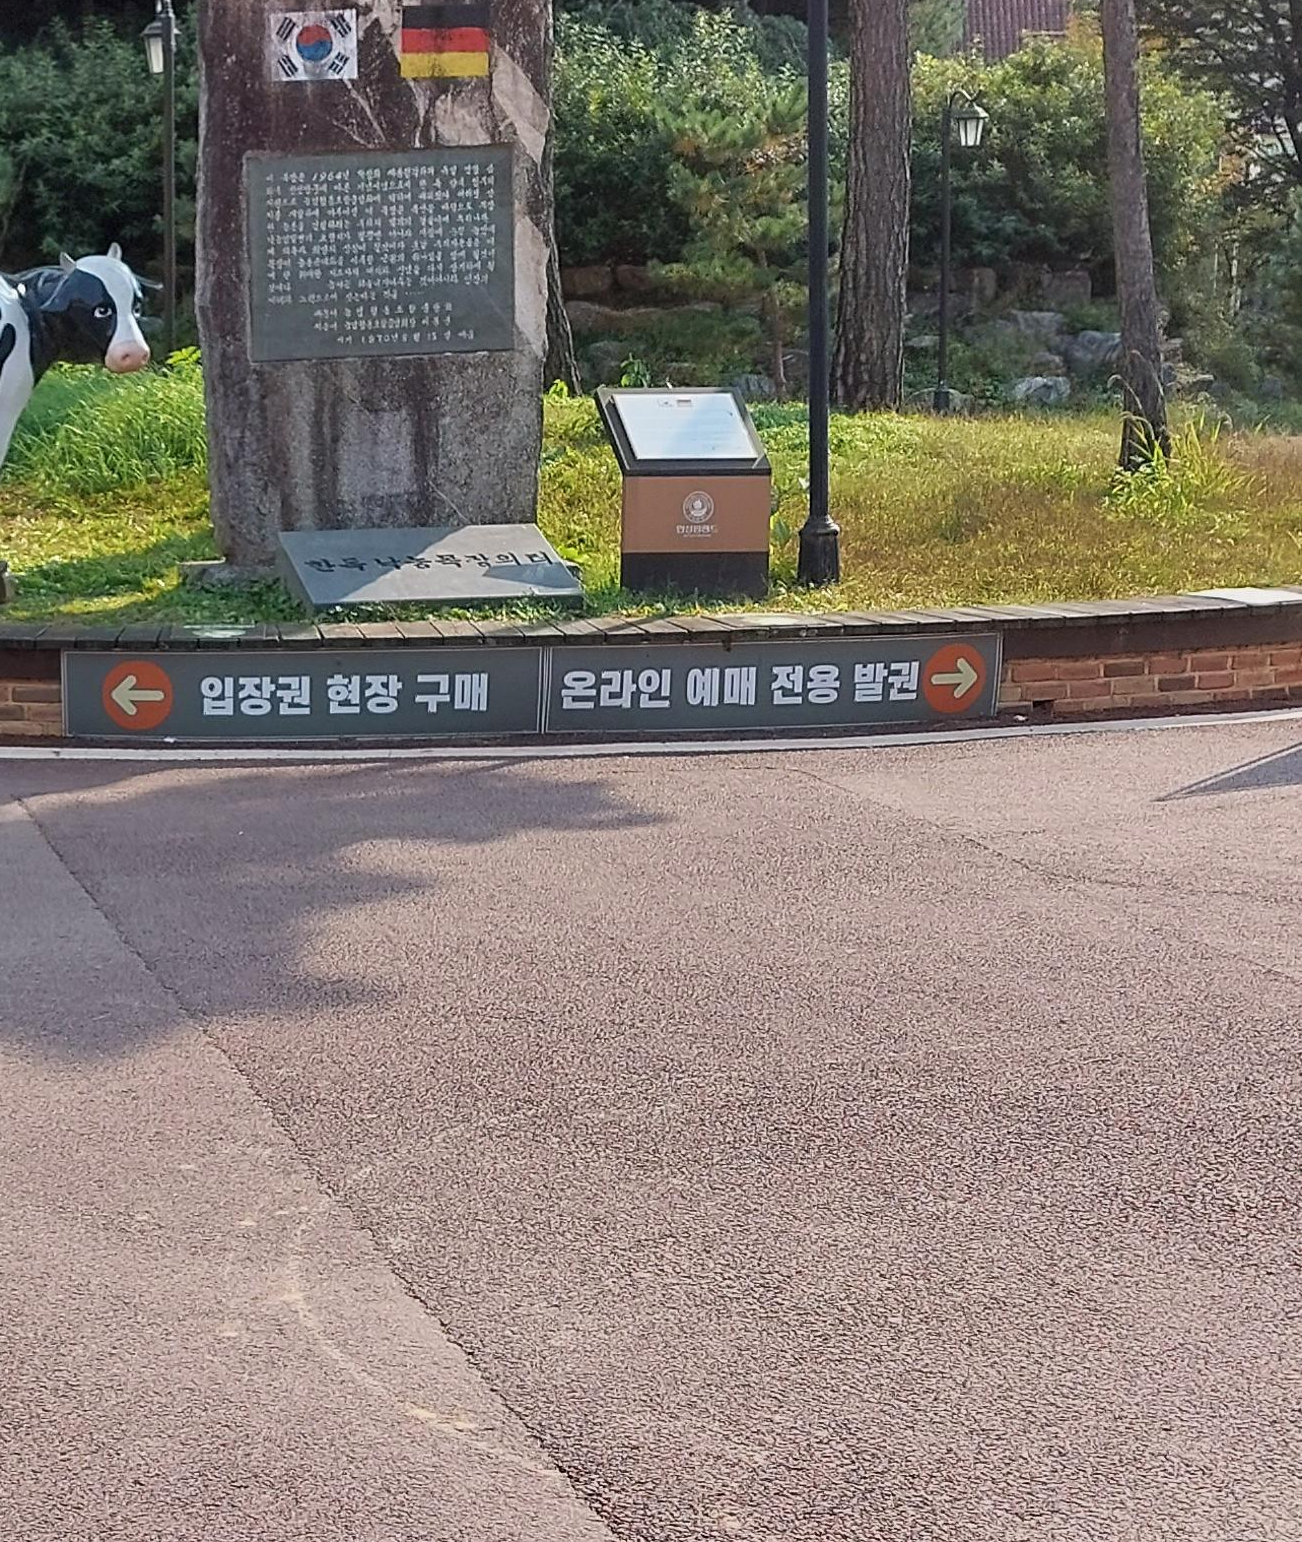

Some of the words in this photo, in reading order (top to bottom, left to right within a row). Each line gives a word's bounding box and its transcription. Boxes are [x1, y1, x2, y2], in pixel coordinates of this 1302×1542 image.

[200, 675, 311, 716] 입장권
[326, 674, 402, 714] 현장
[414, 672, 488, 713] 구매
[561, 668, 671, 709] 온라인
[686, 666, 756, 707] 예매
[770, 664, 840, 705] 전용
[854, 661, 920, 703] 발권
